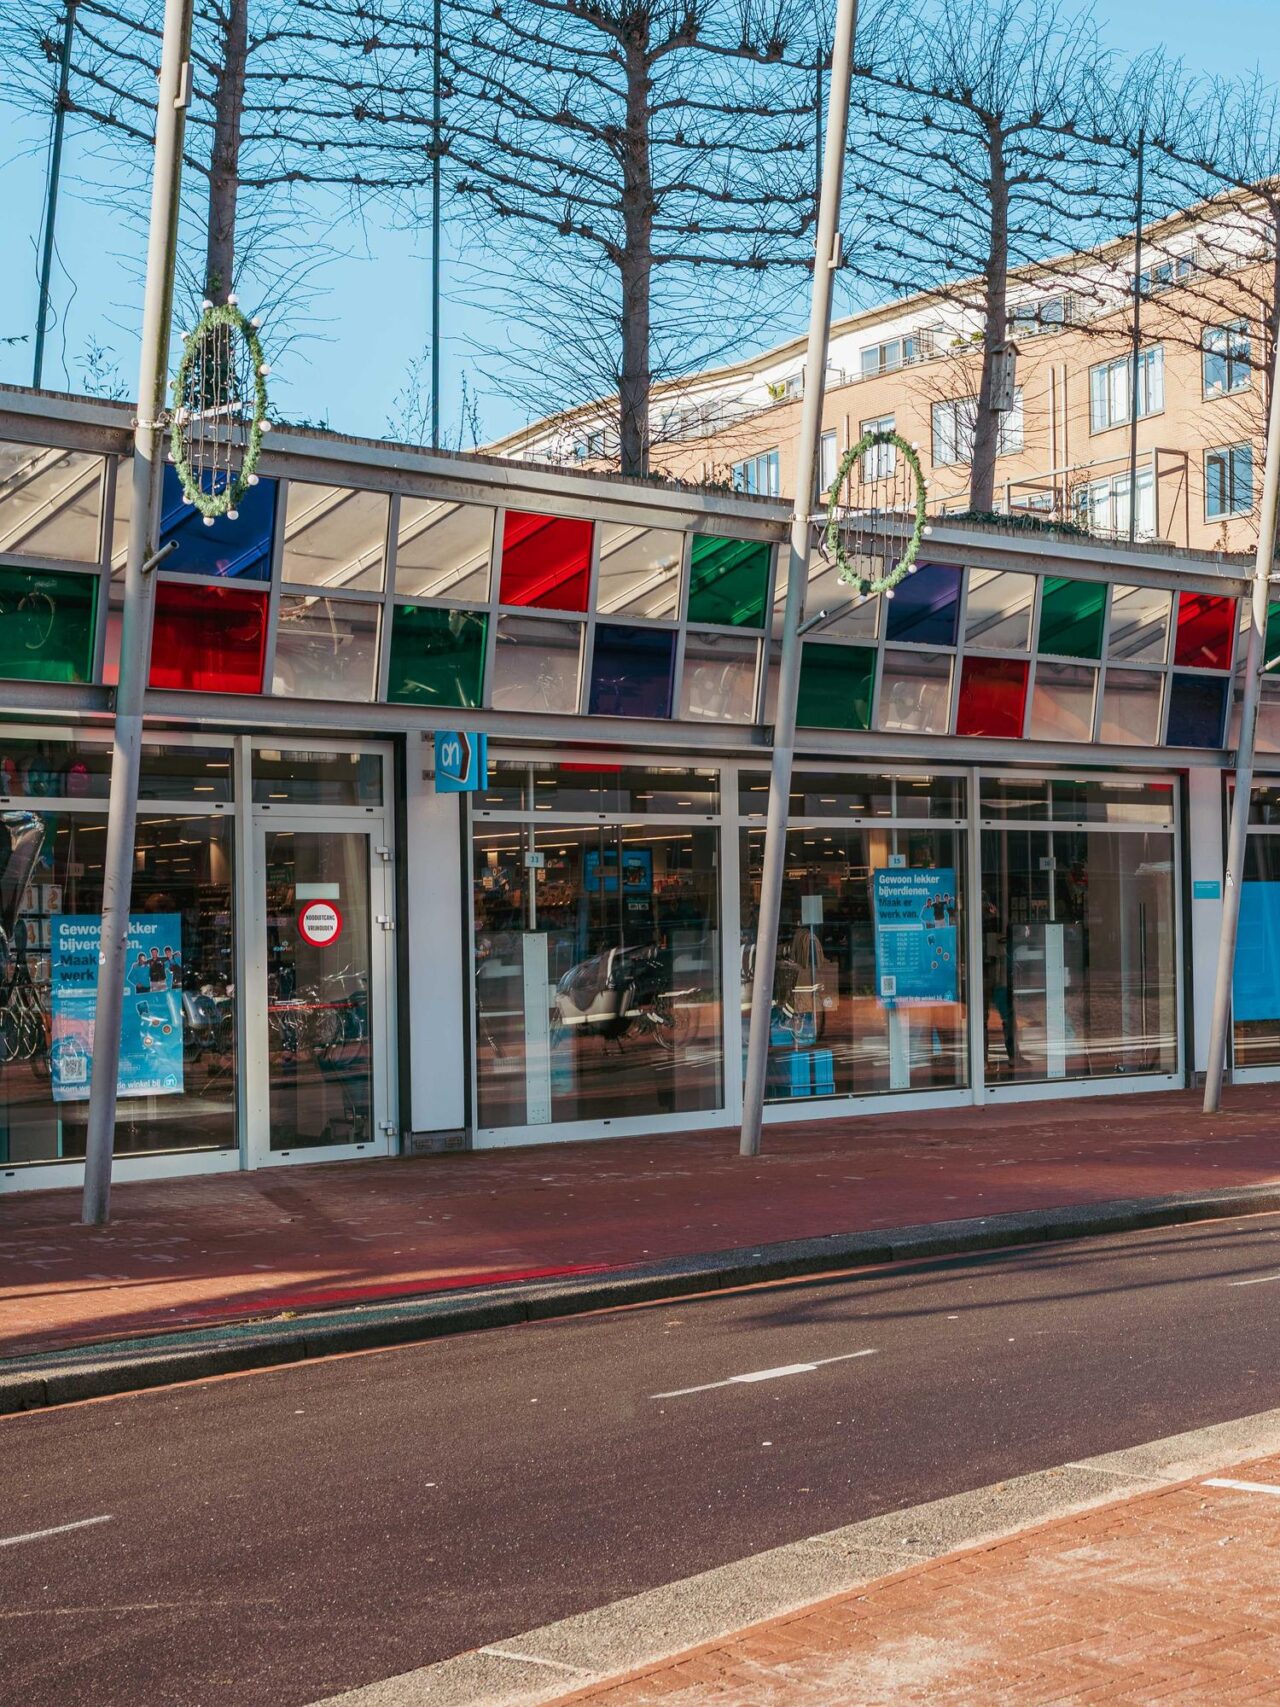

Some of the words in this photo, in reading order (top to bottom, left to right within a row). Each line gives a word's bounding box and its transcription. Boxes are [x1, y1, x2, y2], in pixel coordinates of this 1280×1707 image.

[879, 874, 912, 884] Gewoon
[914, 874, 939, 884] lekker
[878, 886, 930, 898] bijverdienen.
[879, 898, 901, 907] Maak
[880, 910, 901, 919] werk
[902, 911, 919, 919] van.
[59, 923, 102, 936] Gewo
[128, 922, 158, 935] kker
[60, 953, 97, 966] Maak
[60, 968, 94, 981] werk
